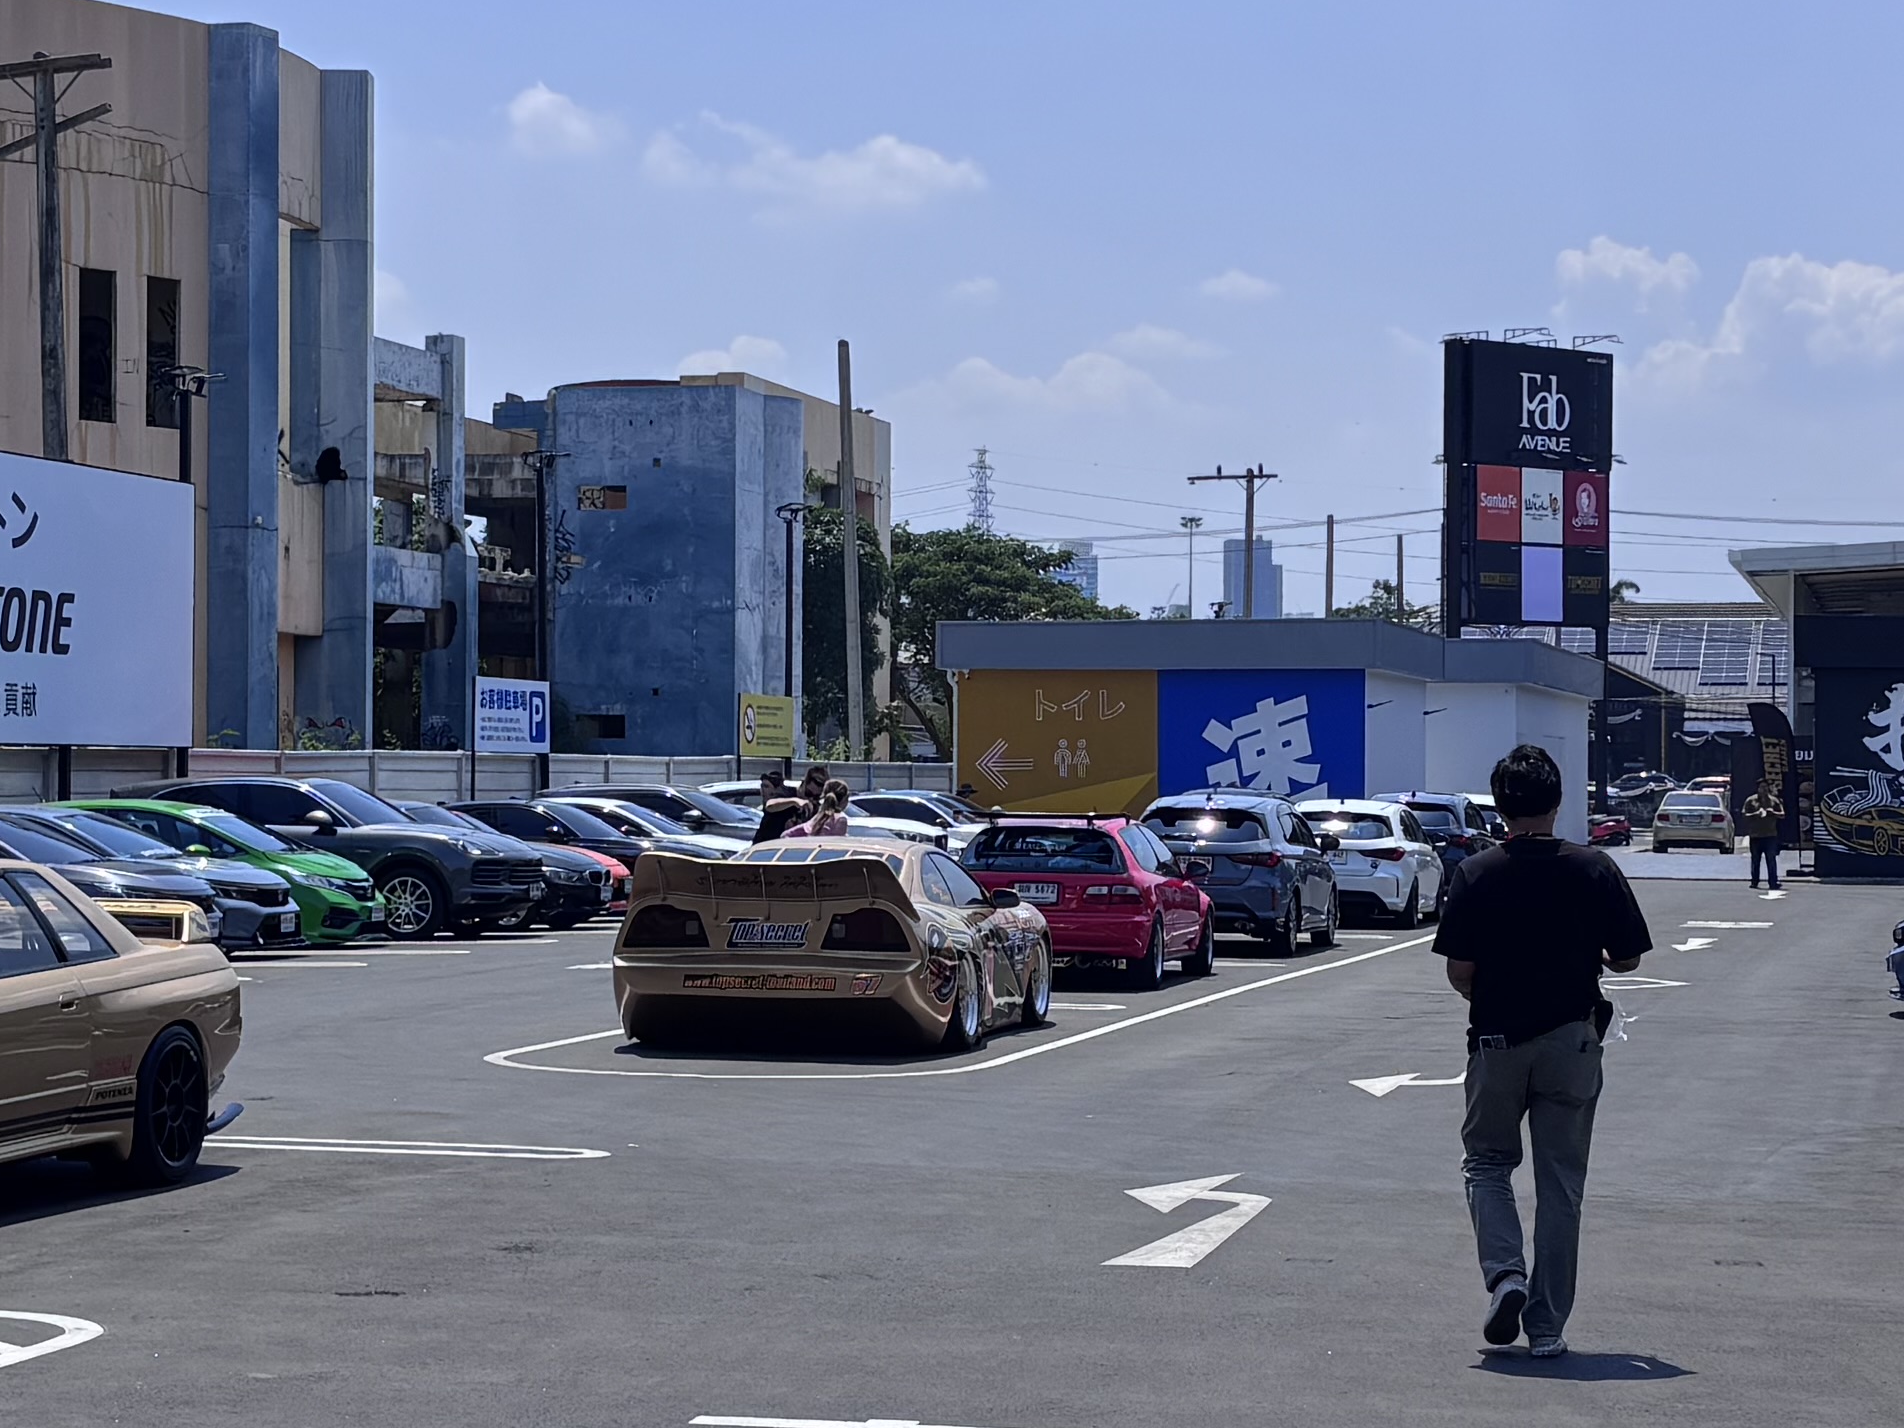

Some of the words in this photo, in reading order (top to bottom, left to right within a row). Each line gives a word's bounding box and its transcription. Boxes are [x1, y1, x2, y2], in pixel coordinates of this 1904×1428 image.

[1518, 372, 1571, 431] Fab
[1518, 434, 1571, 452] AVENUE
[1034, 688, 1126, 722] トイレ
